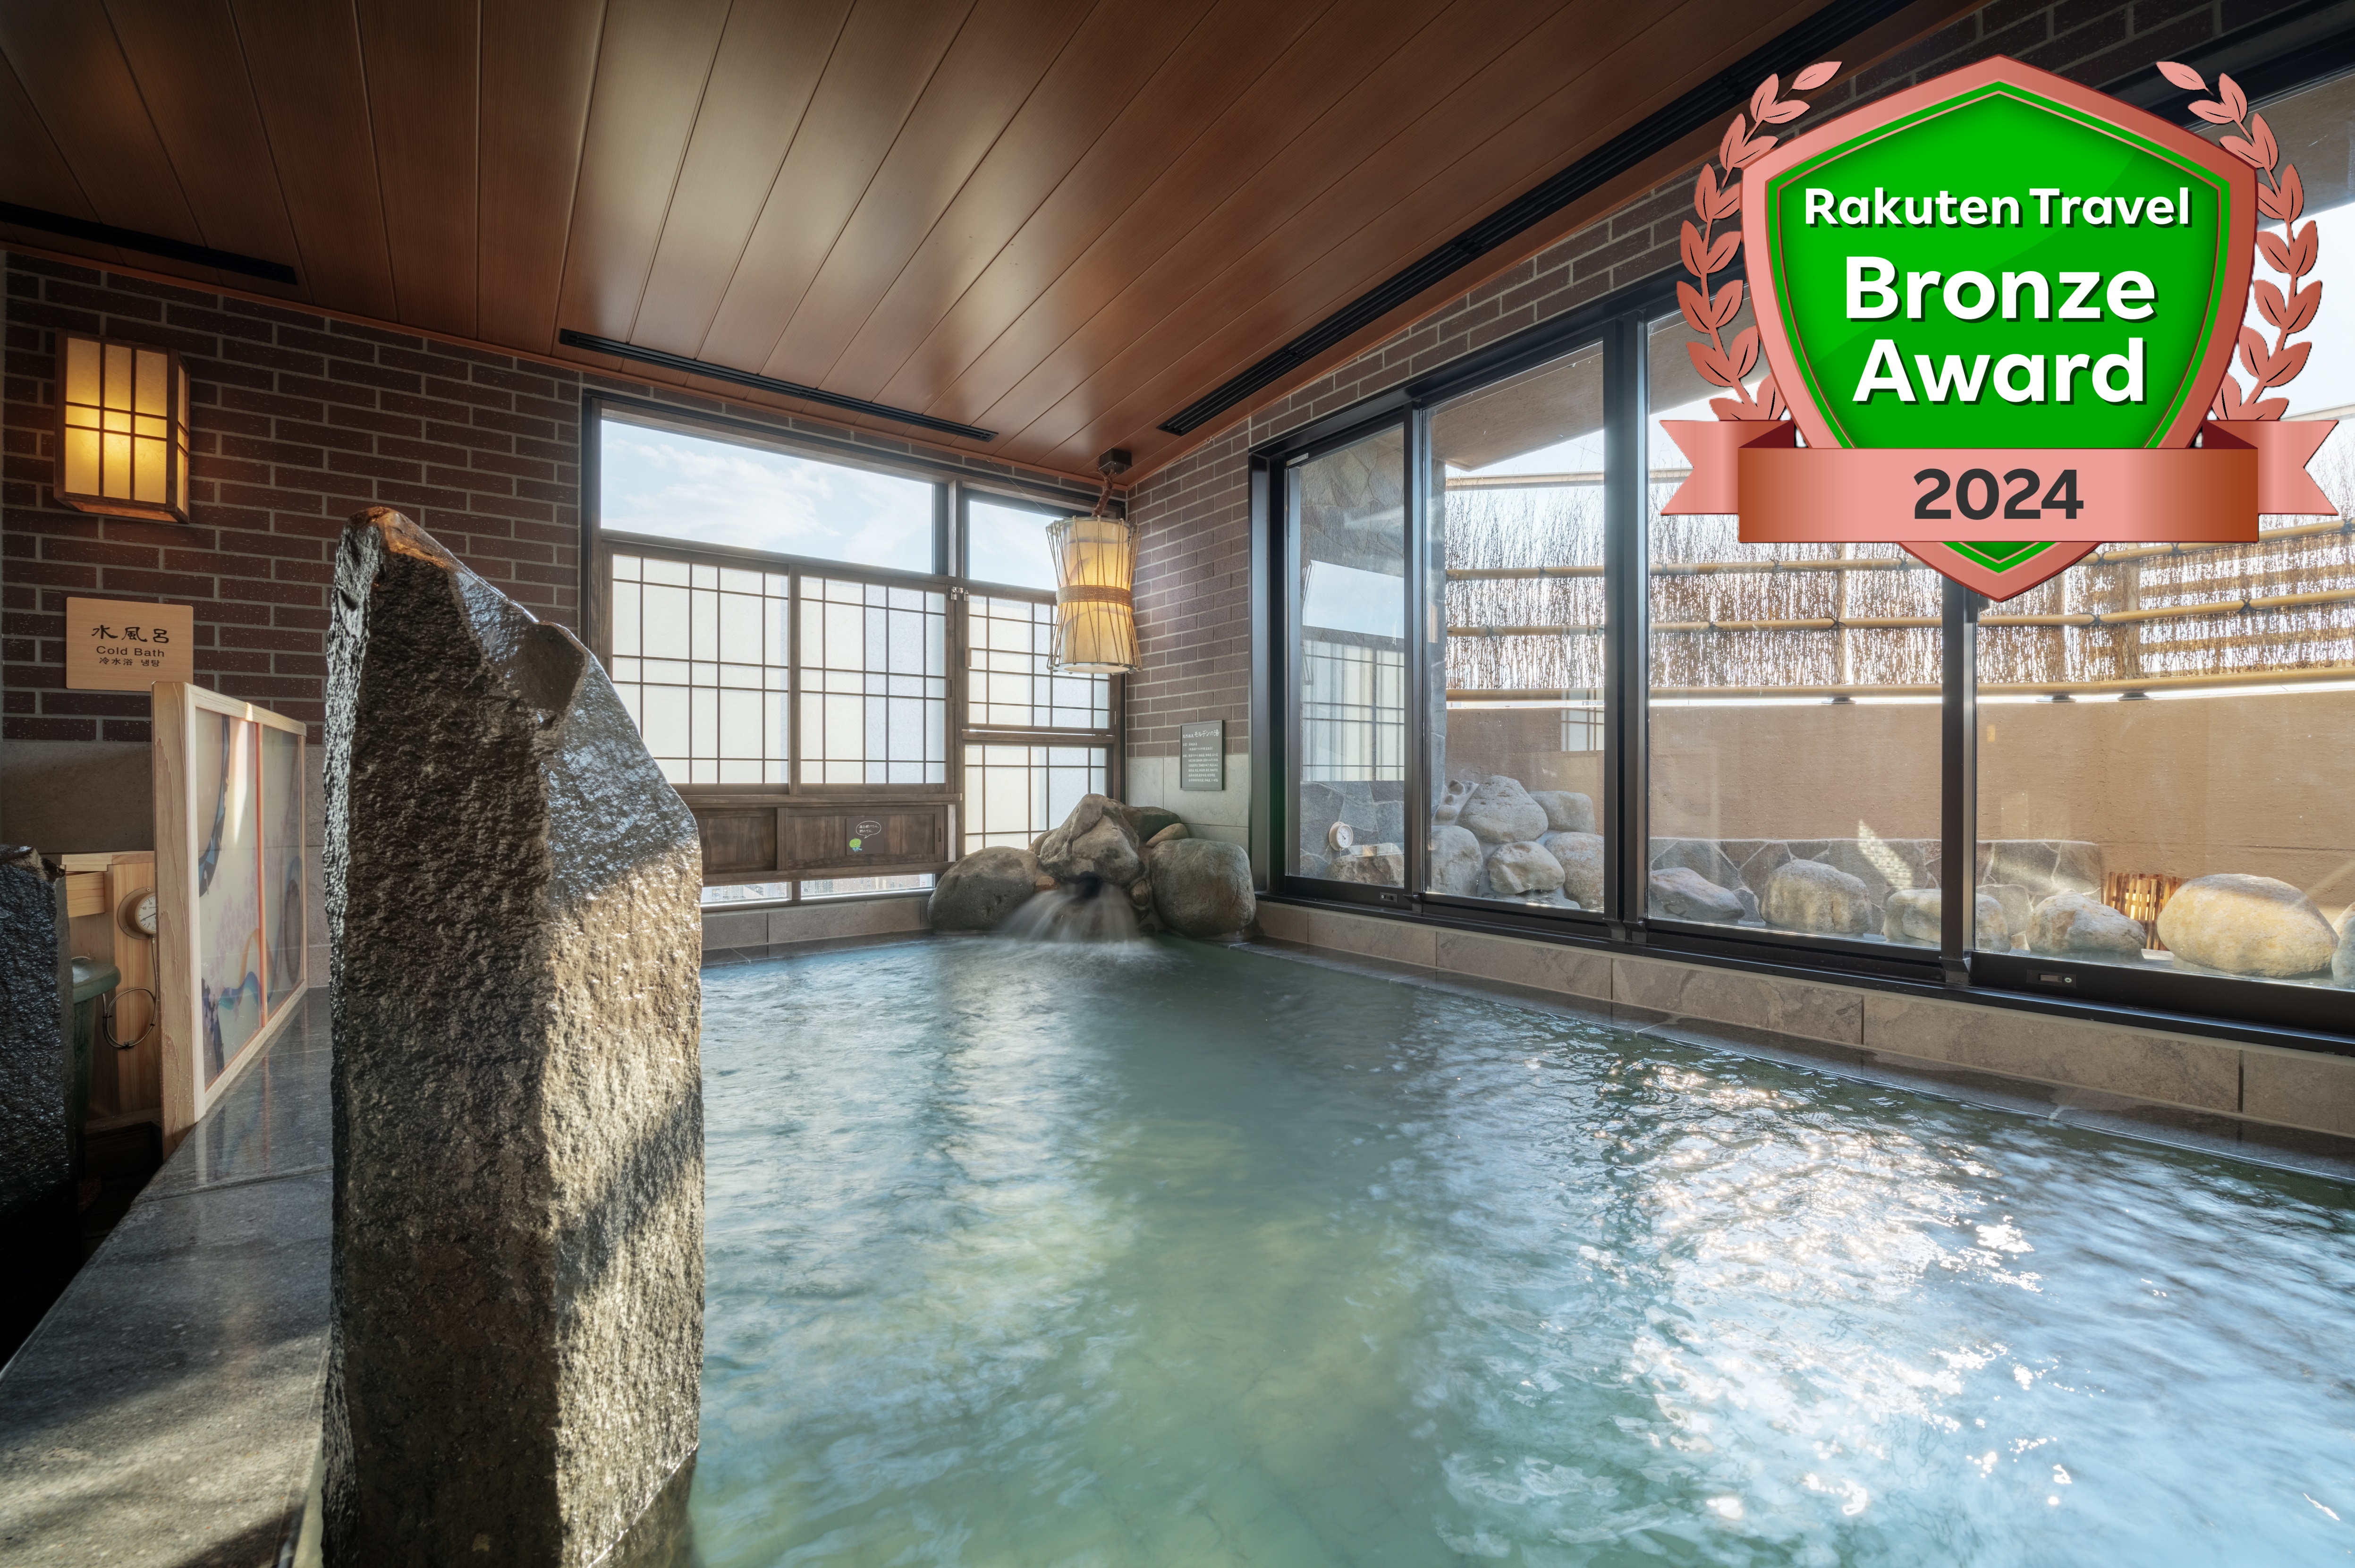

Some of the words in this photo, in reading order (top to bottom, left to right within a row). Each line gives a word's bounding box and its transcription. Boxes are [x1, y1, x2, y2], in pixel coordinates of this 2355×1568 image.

[91, 624, 169, 644] 水風呂
[96, 645, 128, 655] Cold
[134, 648, 165, 657] Bath
[99, 657, 133, 666] 冷水浴
[141, 659, 161, 667] 냉탕
